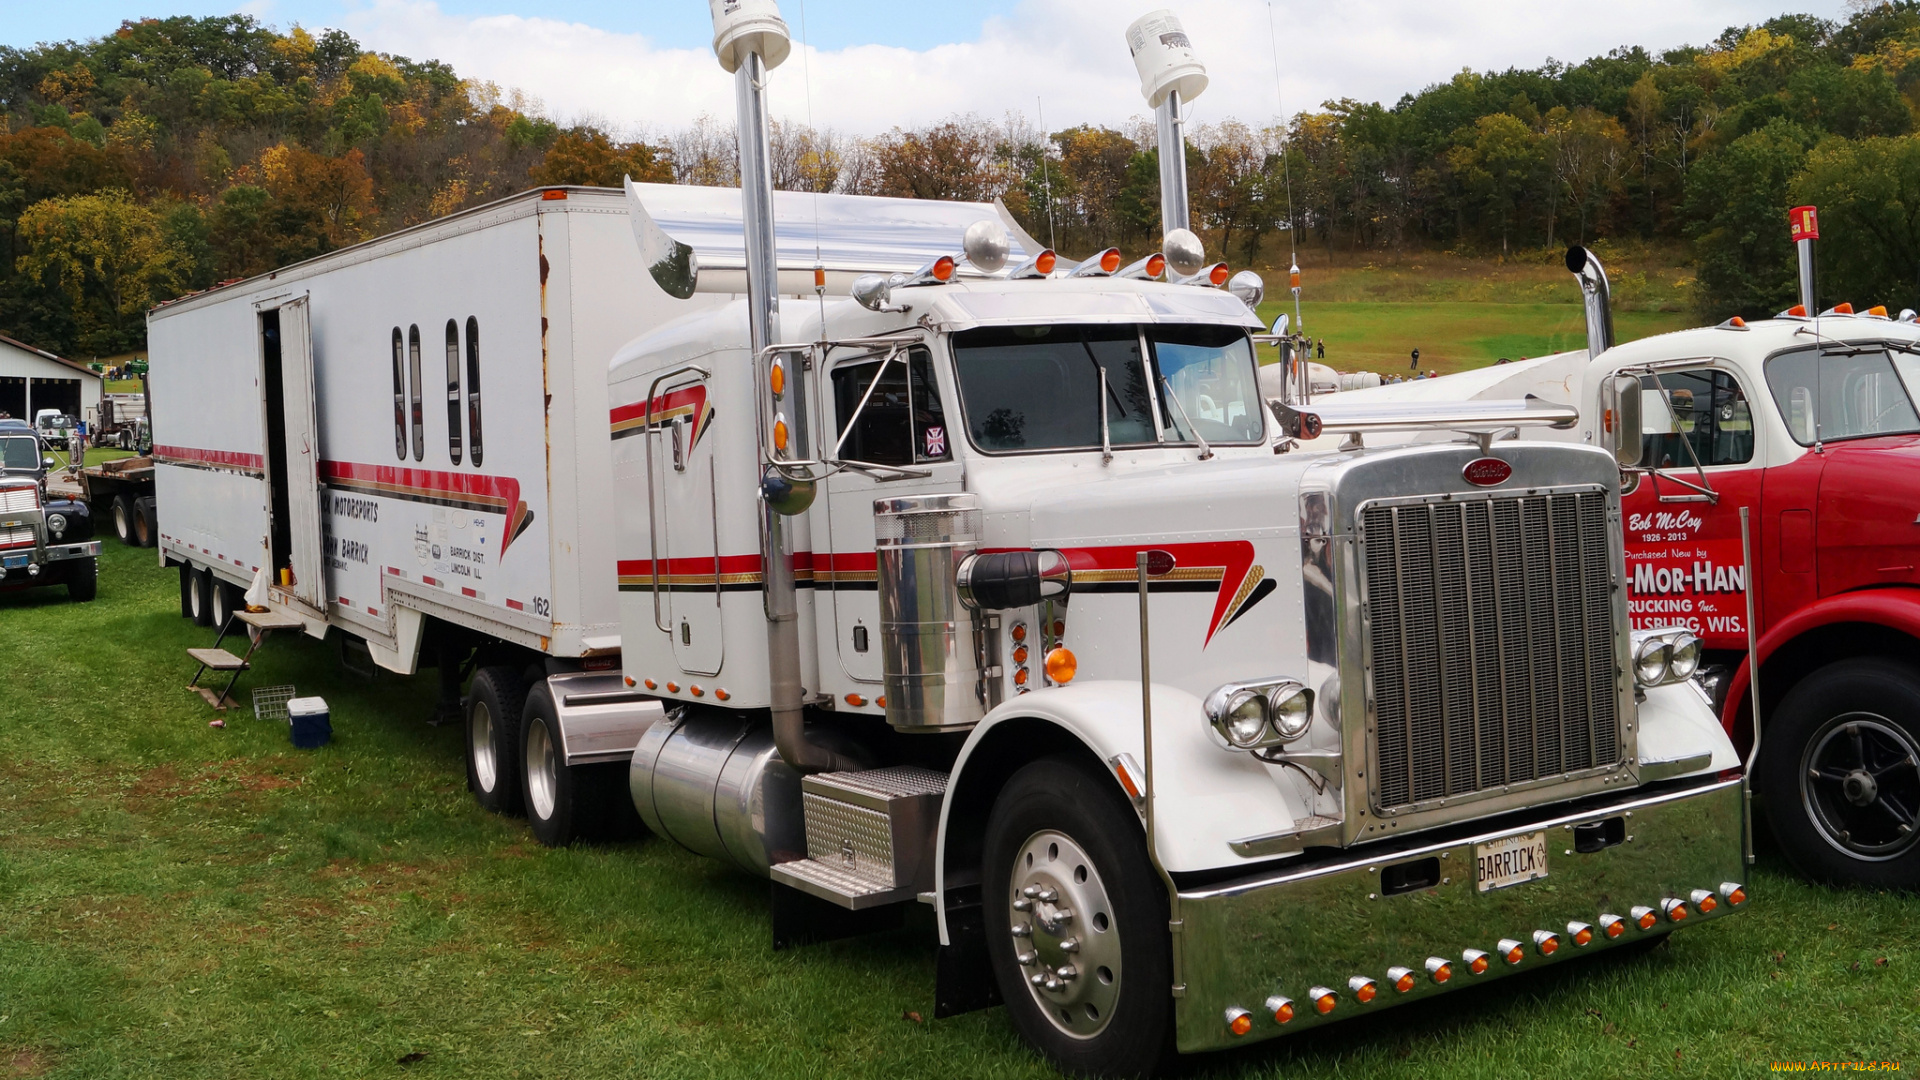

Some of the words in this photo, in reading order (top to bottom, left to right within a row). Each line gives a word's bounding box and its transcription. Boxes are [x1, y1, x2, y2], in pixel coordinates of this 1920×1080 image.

[334, 496, 379, 523] MOTORSPORTS
[1629, 513, 1653, 532] Bob
[1655, 509, 1702, 533] McCoy
[1642, 533, 1661, 542] 1926
[1667, 532, 1687, 542] 2013
[342, 538, 369, 565] BARRICK
[450, 546, 471, 560] BARRICK
[472, 551, 486, 564] DIST.
[1624, 549, 1667, 560] Purchased
[1671, 548, 1691, 559] New
[1696, 547, 1707, 559] by
[451, 562, 471, 576] LINCOLN
[533, 595, 550, 617] 162
[1697, 599, 1718, 613] Inc.
[1706, 615, 1746, 633] WIS.
[1478, 845, 1535, 882] BARRICK
